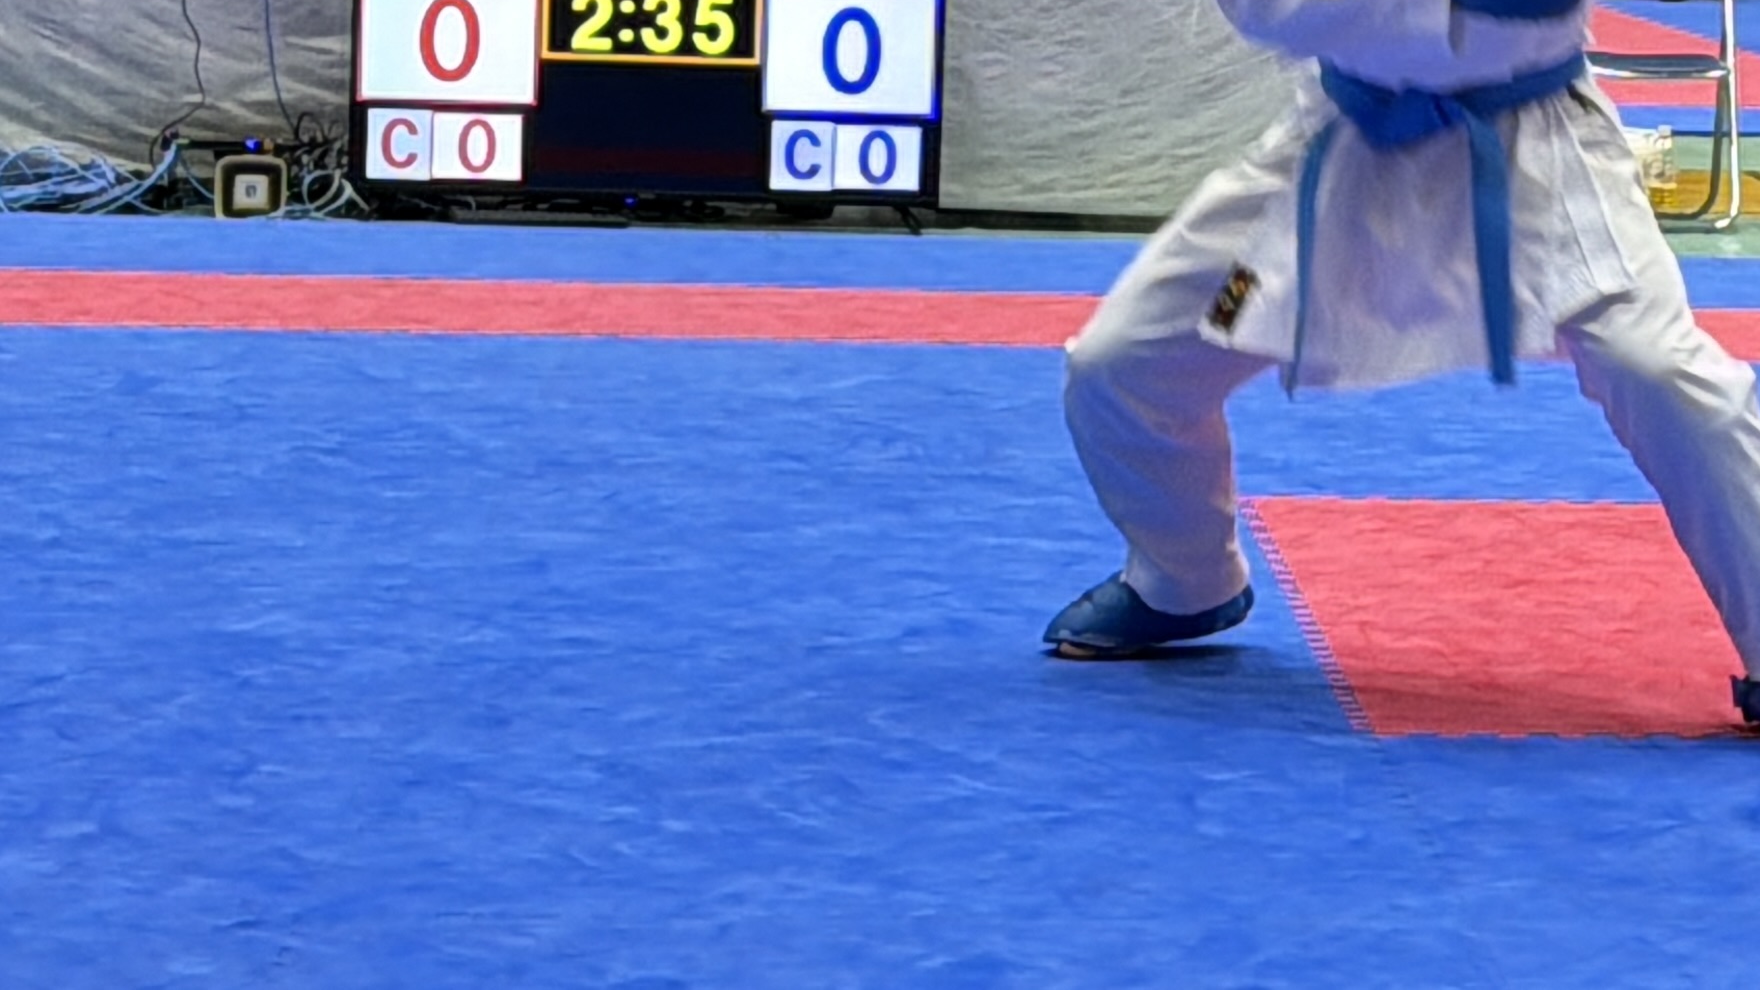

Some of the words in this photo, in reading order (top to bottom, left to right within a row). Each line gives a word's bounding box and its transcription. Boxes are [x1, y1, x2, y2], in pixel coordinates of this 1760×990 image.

[821, 6, 882, 94] 0
[380, 117, 419, 169] C
[457, 117, 497, 174] 0
[784, 128, 822, 180] C
[858, 129, 898, 185] 0
